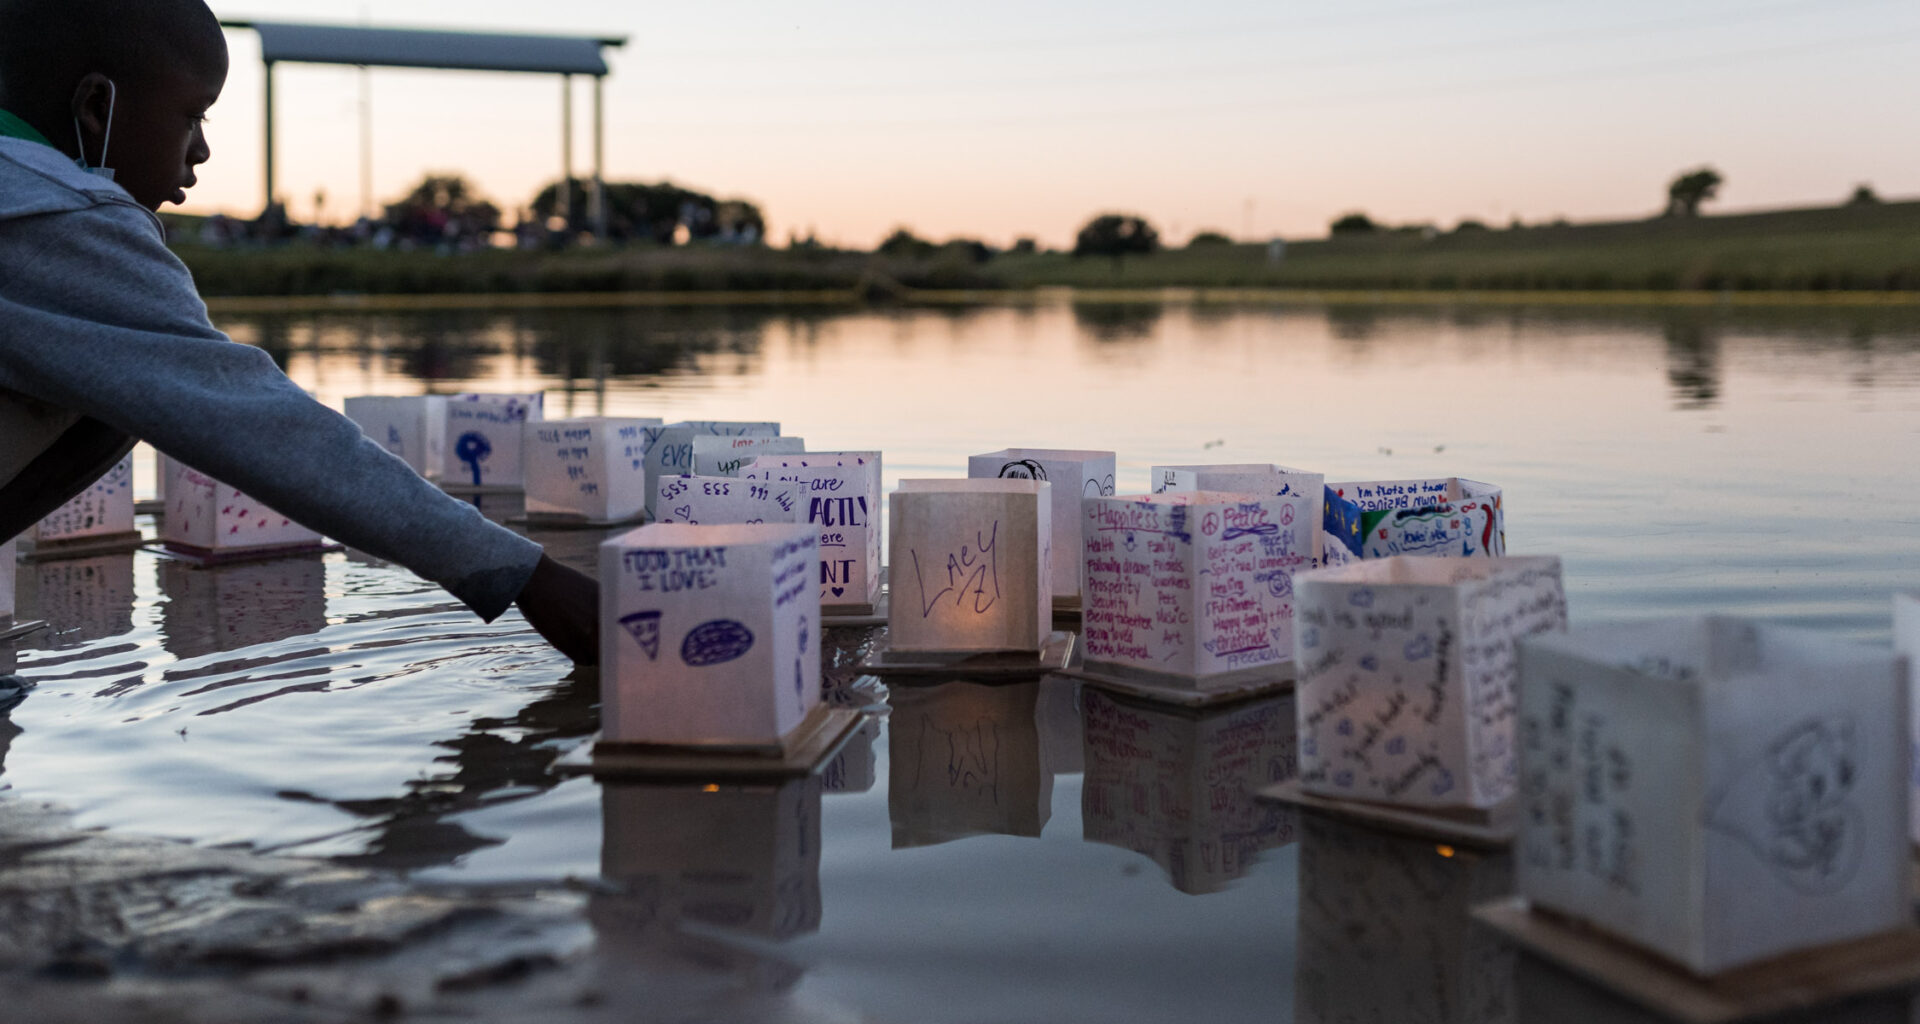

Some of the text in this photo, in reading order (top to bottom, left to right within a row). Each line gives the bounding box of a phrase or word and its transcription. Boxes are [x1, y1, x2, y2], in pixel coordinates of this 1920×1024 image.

[811, 478, 844, 491] are
[808, 496, 868, 528] ACTLY
[1097, 503, 1160, 534] Happiness
[1223, 508, 1270, 530] Peace
[1088, 576, 1141, 604] Prosperity
